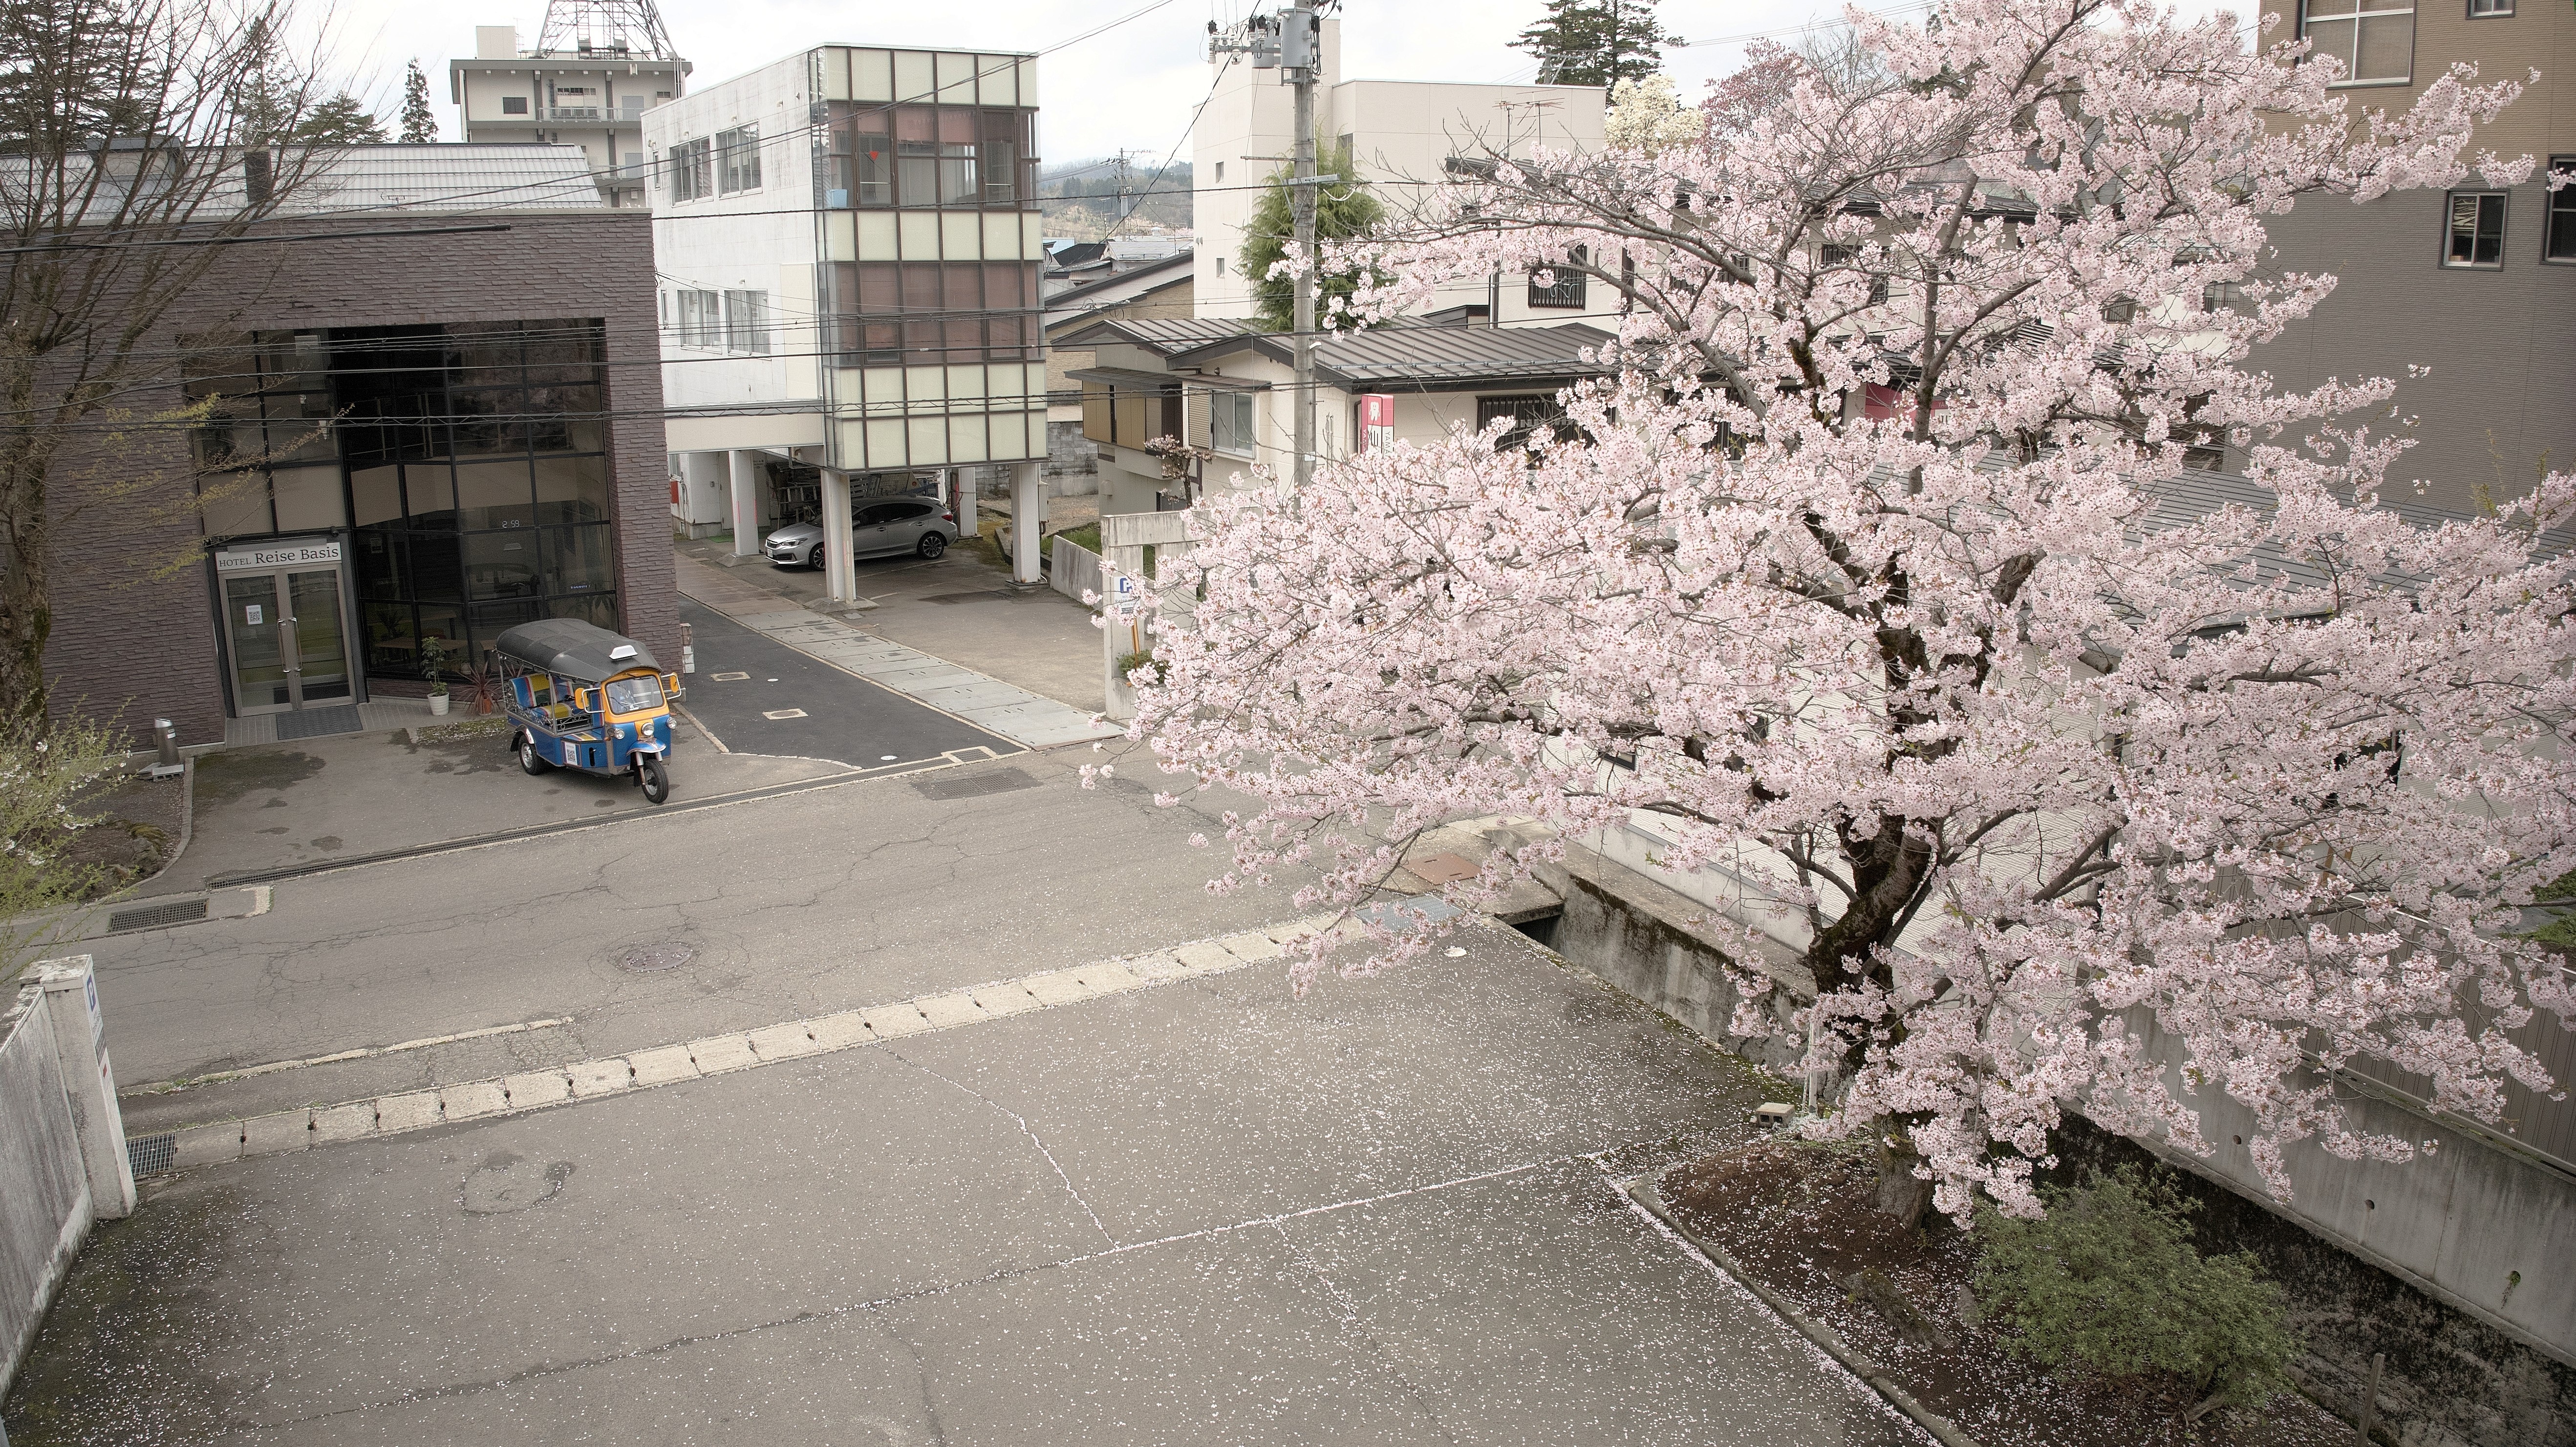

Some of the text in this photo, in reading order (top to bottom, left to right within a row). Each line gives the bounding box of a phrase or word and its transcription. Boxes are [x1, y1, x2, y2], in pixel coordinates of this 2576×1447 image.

[219, 547, 339, 567] HOTEL Reise Basis
[88, 981, 94, 1006] P
